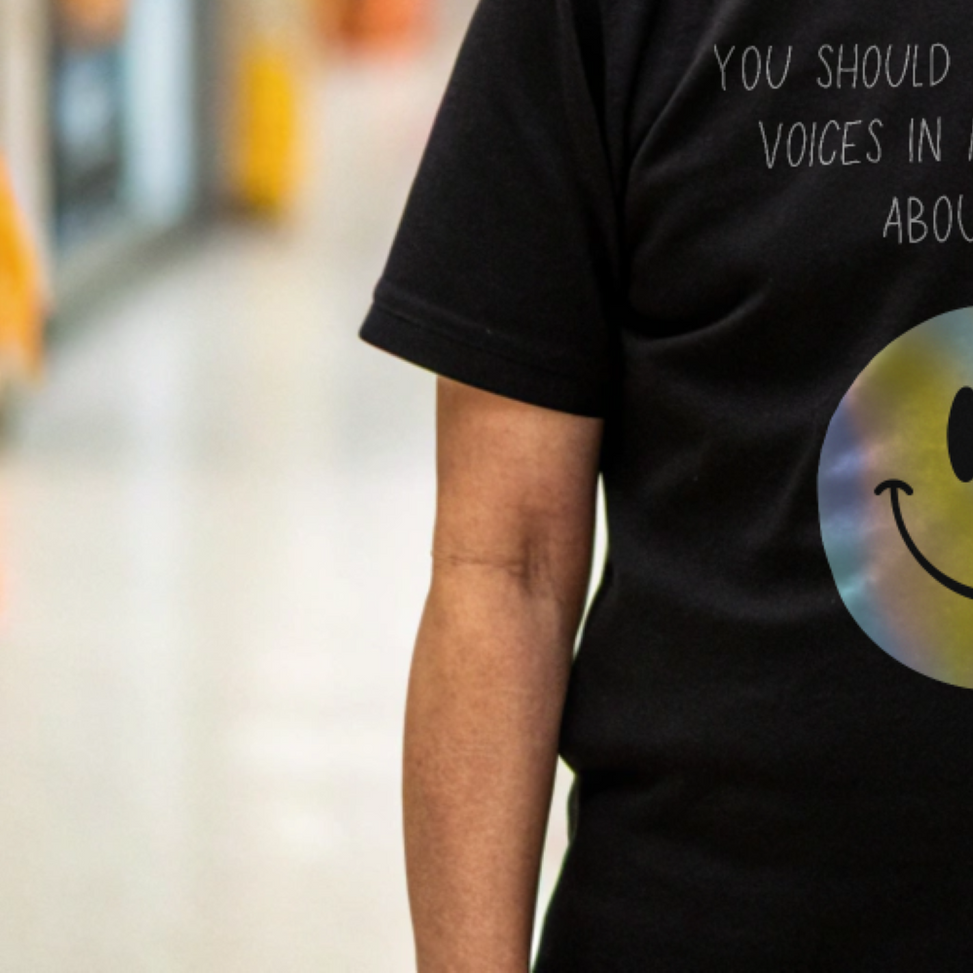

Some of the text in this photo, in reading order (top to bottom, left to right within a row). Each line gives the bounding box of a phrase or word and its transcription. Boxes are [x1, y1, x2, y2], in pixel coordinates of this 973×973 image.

[714, 45, 792, 90] YOU
[817, 43, 951, 88] SHOULD
[759, 119, 883, 168] VOICES
[909, 117, 942, 162] IN
